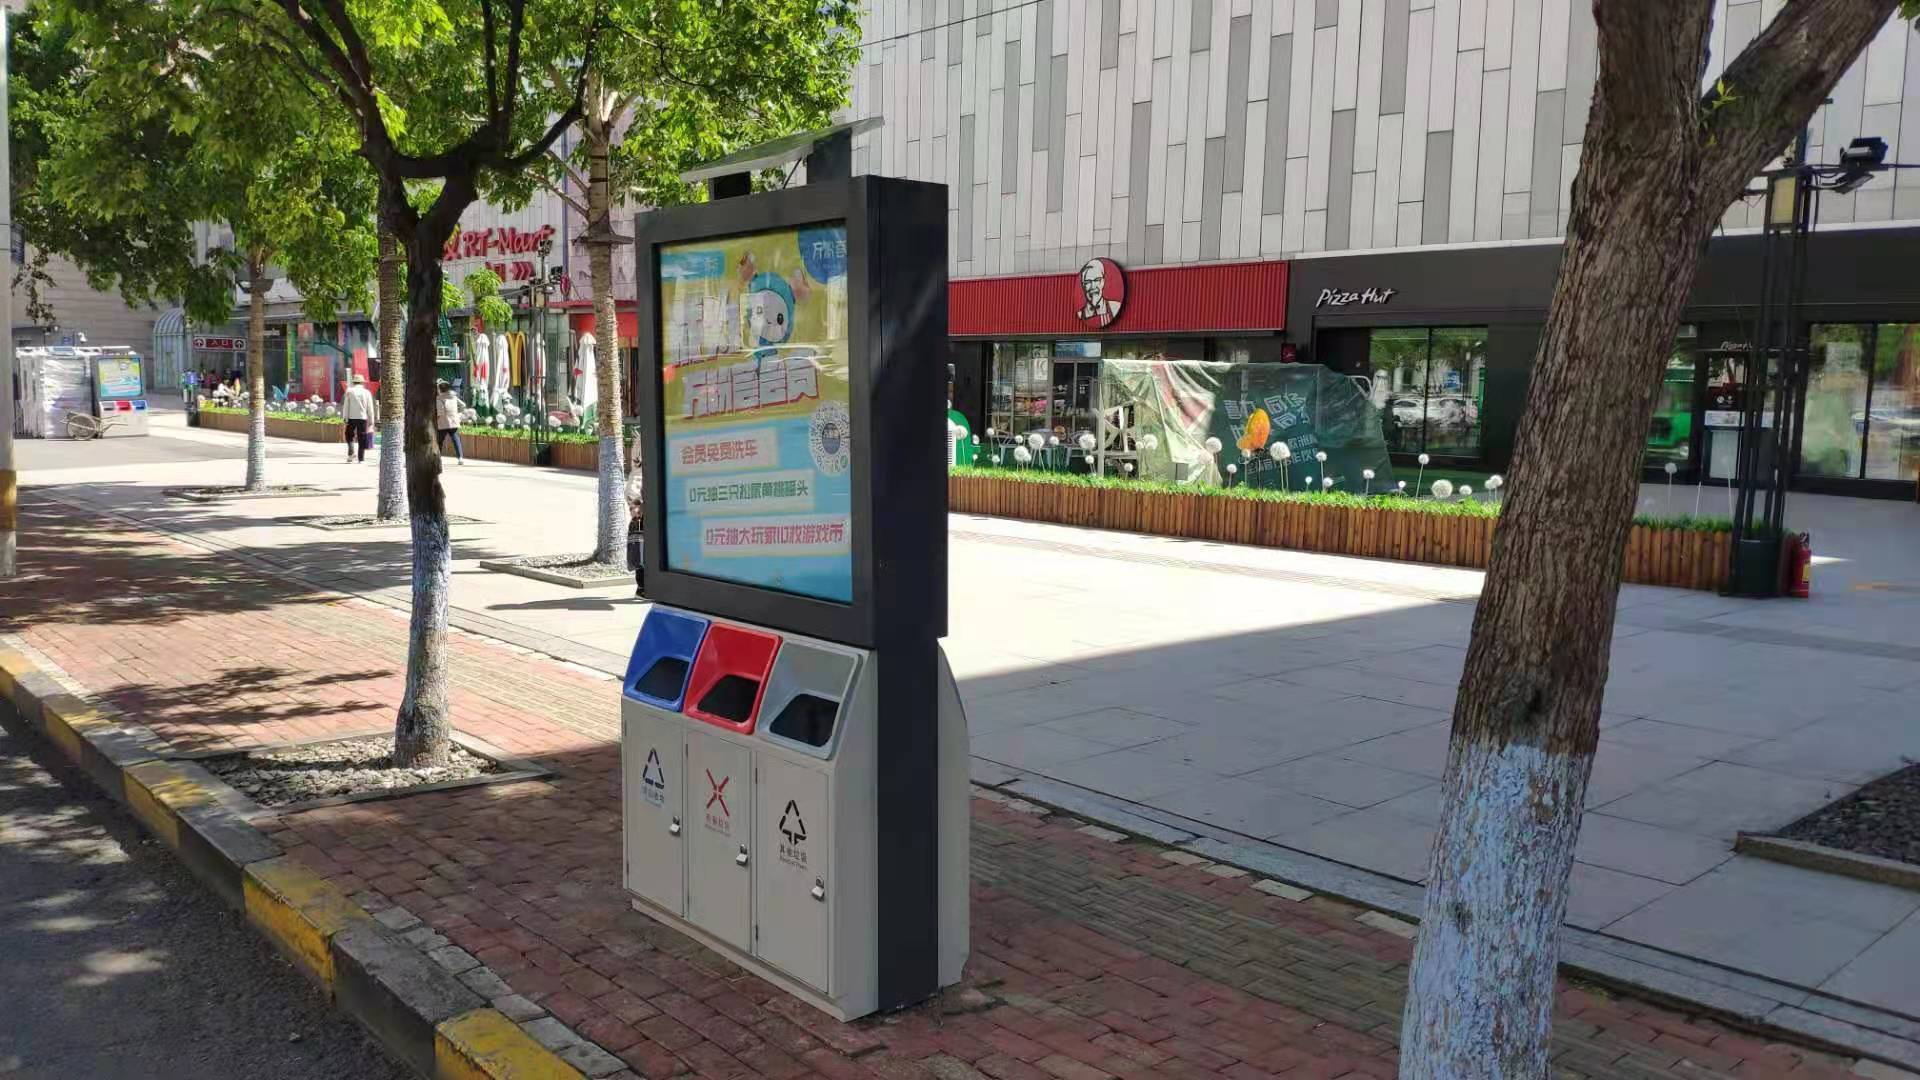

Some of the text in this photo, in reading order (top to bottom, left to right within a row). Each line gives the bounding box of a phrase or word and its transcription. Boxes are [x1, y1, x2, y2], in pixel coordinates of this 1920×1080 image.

[463, 224, 555, 257] RT-Mart
[1315, 287, 1396, 308] Pizza Hut
[681, 440, 758, 465] 会员免费洗车
